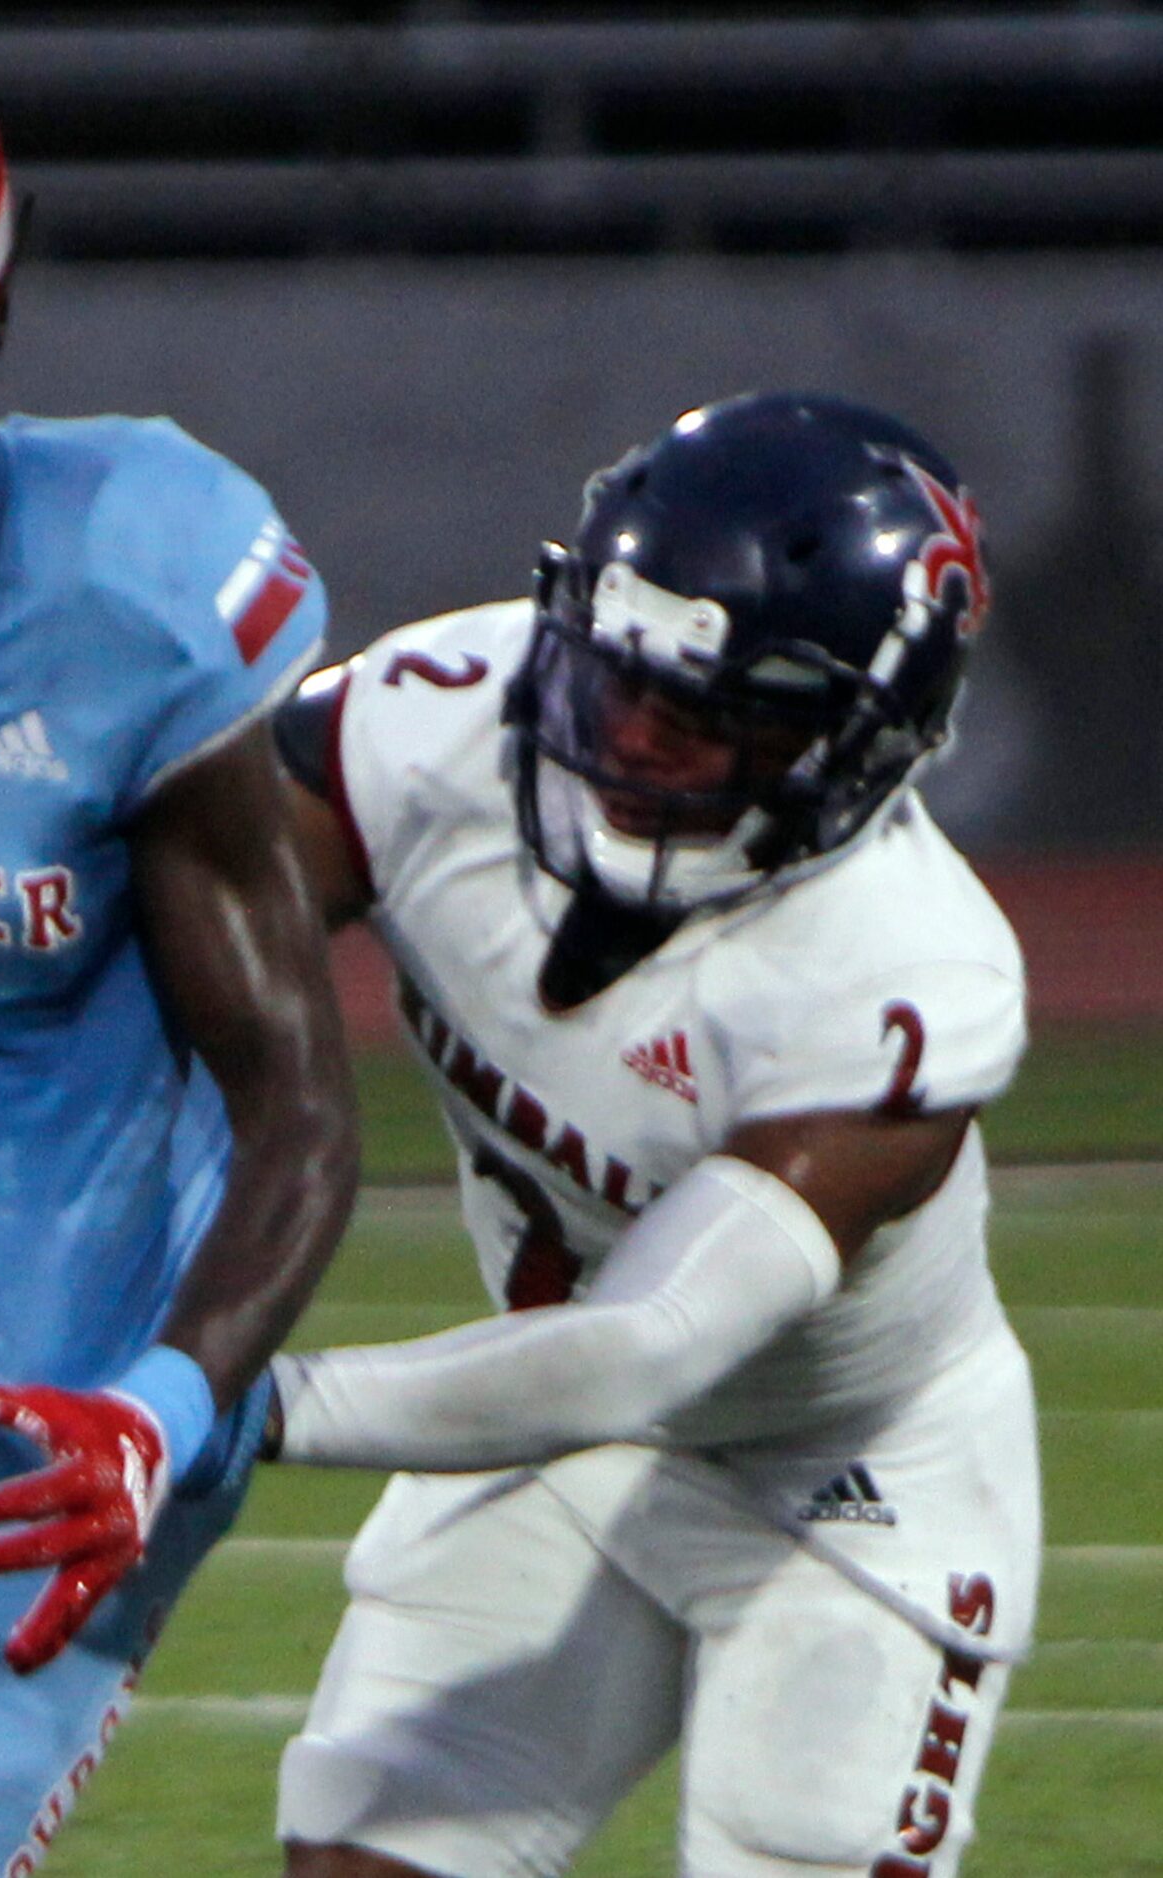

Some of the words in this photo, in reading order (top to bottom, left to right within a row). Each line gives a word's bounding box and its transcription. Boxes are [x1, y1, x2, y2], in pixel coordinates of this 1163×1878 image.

[379, 650, 491, 688] 2
[397, 962, 664, 1217] IMBAL
[878, 997, 929, 1118] 2
